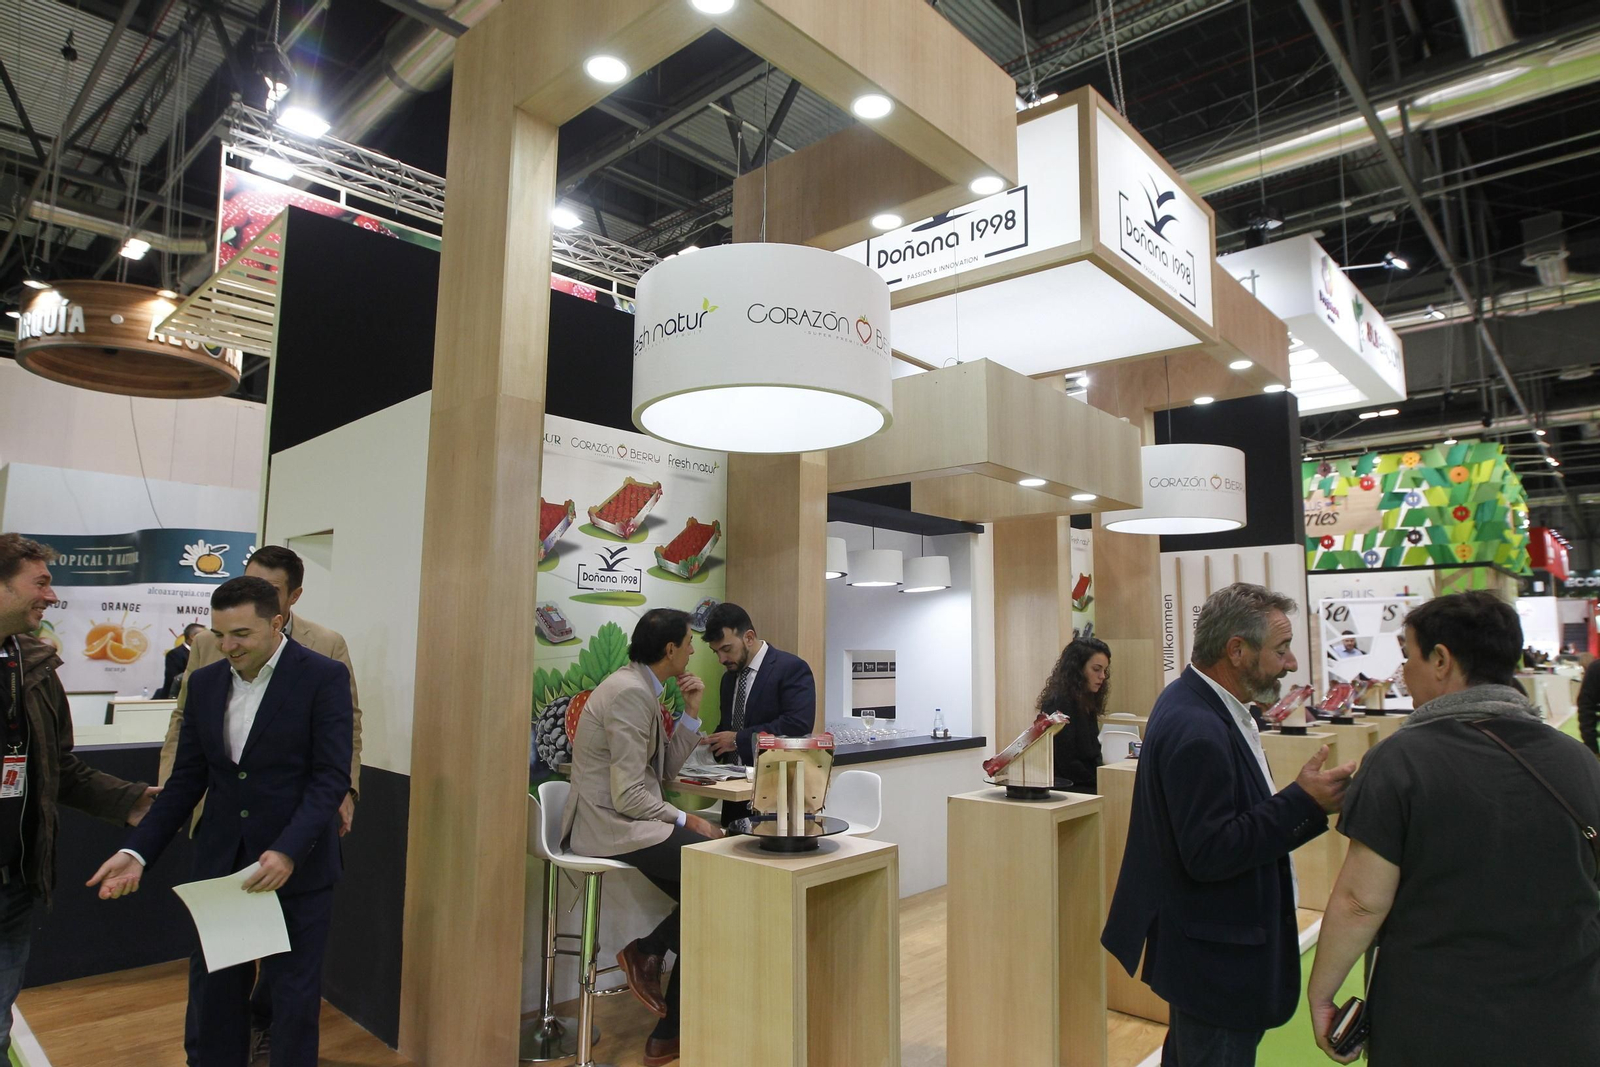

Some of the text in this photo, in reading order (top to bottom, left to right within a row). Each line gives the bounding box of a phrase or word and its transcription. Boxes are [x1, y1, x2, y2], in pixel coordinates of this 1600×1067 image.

[877, 209, 1016, 269] Doñana 1998
[1126, 215, 1168, 268] Doñana
[1172, 254, 1191, 285] 1998
[907, 268, 932, 280] PASSION
[939, 255, 978, 271] INNOVATION
[653, 310, 708, 342] natur
[543, 433, 561, 445] UR
[630, 448, 660, 463] BERRY
[668, 454, 691, 469] fresh
[692, 462, 716, 474] natur
[48, 554, 103, 566] OPICAL
[107, 554, 114, 566] Y
[582, 571, 638, 584] Doñana 1998
[101, 602, 141, 613] ORANGE
[177, 605, 210, 616] MANGO
[1163, 594, 1174, 671] Willkommen
